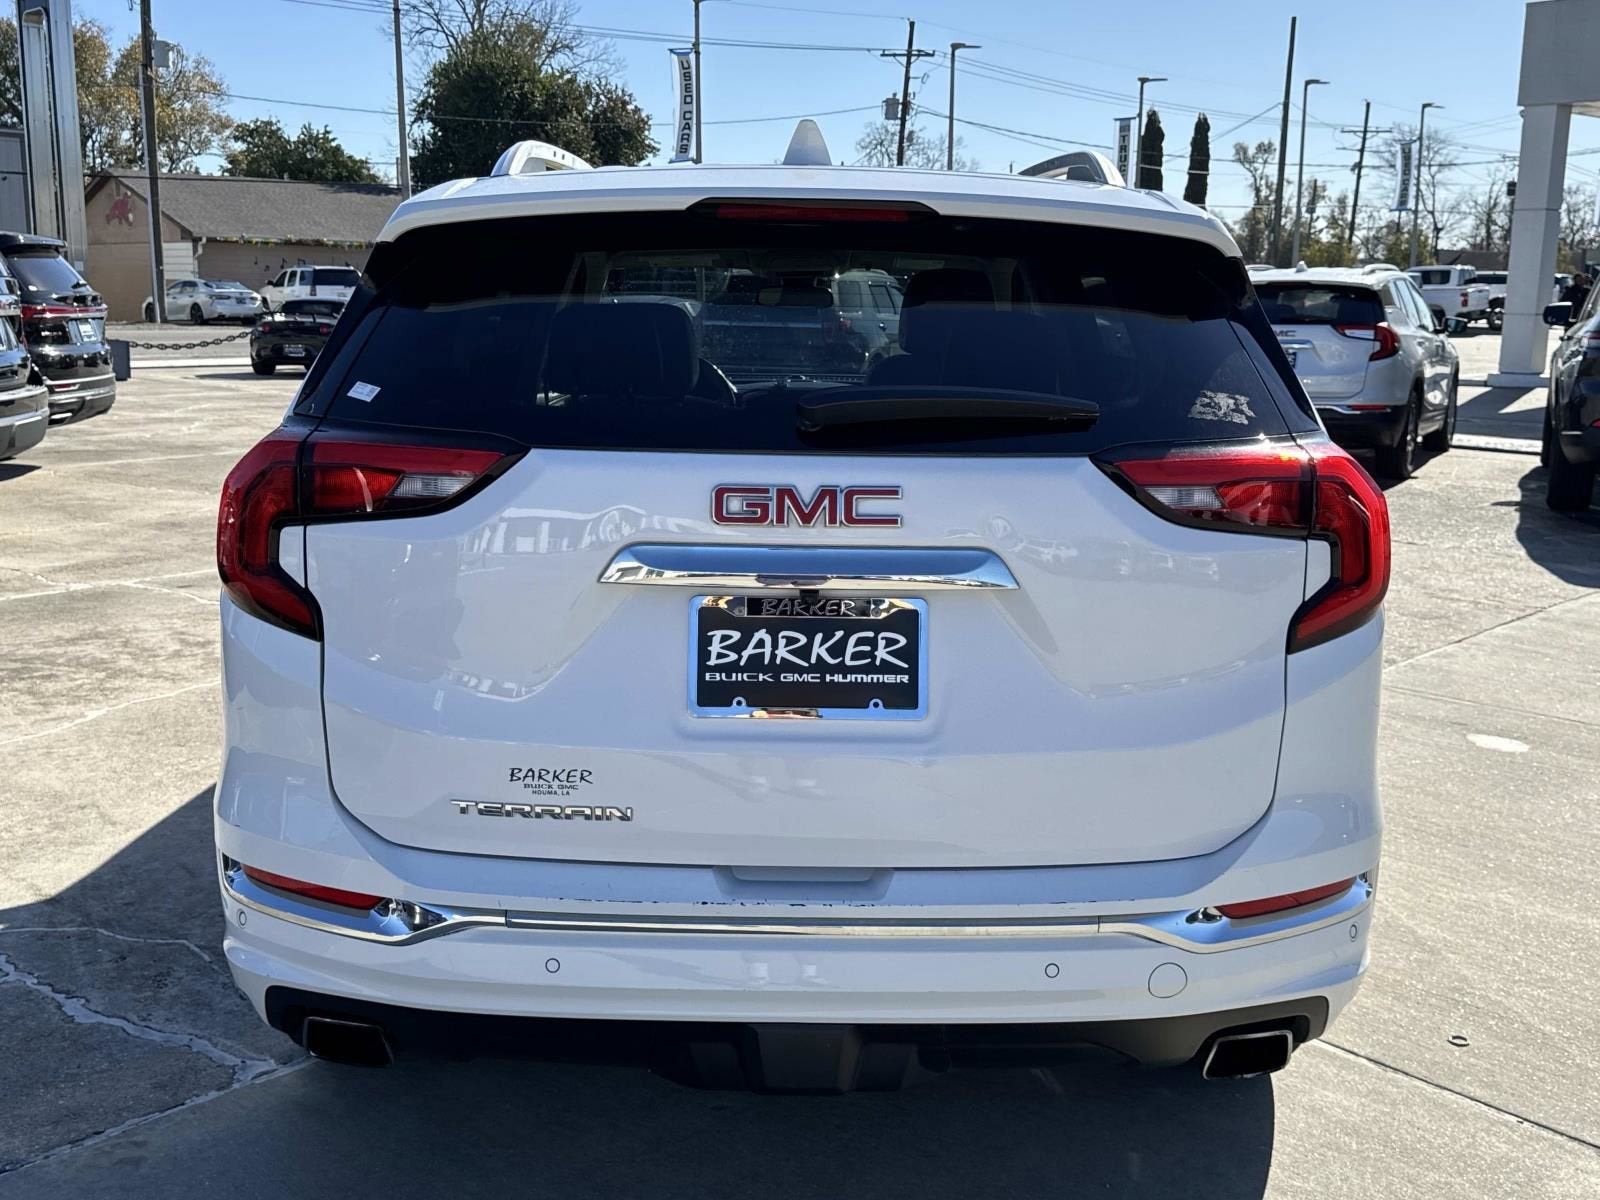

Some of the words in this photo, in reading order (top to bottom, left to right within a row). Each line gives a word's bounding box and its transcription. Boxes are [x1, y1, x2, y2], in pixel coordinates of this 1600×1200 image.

[681, 60, 693, 105] USED
[679, 110, 692, 154] CARS
[711, 483, 903, 528] GMC
[760, 598, 857, 617] BARKER
[706, 628, 909, 668] BARKER
[705, 672, 775, 682] BUICK
[780, 673, 821, 683] GMC
[825, 673, 910, 684] HUMMER
[509, 767, 593, 784] BARKER
[450, 800, 633, 822] TERRAIN
